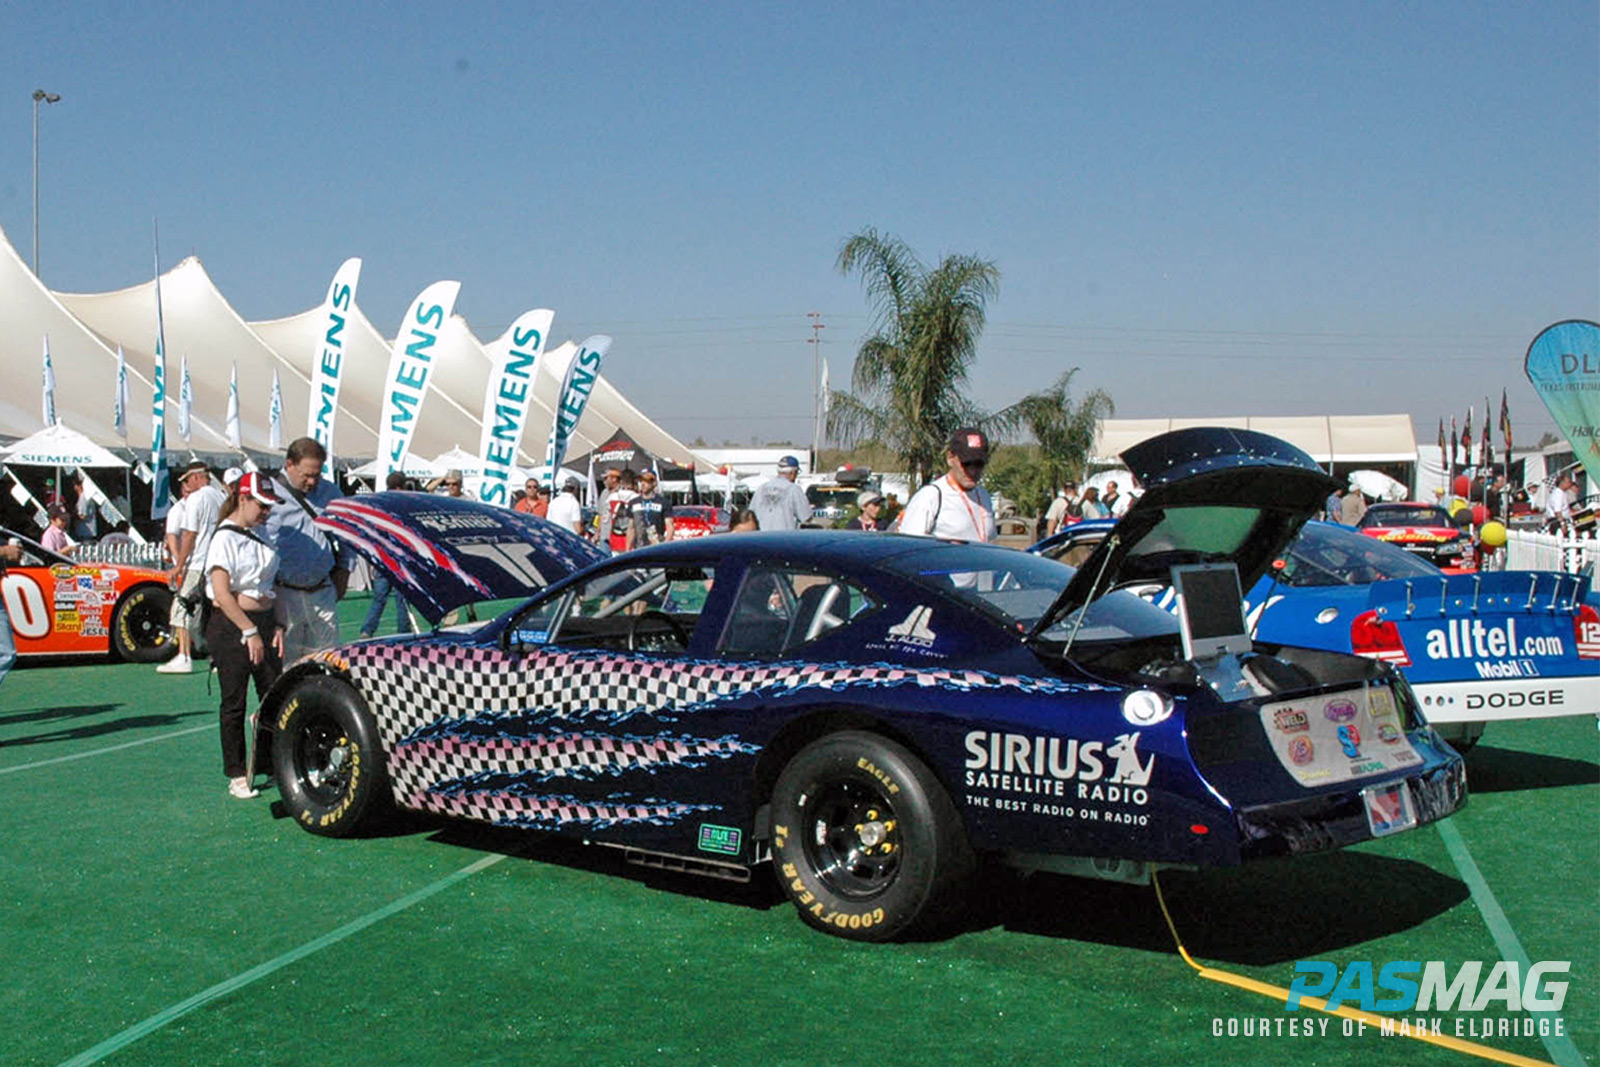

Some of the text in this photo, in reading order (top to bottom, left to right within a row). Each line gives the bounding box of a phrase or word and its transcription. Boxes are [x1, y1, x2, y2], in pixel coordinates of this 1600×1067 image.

[1562, 353, 1600, 374] DL
[480, 326, 541, 505] SIEMENS
[21, 454, 93, 464] SIEMENS
[101, 592, 117, 601] 3M
[1426, 618, 1564, 660] alltel.com
[1475, 659, 1519, 678] Mobil
[279, 699, 299, 730] EAGLE
[1466, 690, 1564, 710] DODGE
[964, 730, 1104, 782] SIRIUS
[320, 742, 360, 826] GOODYEAR
[857, 757, 900, 794] EAGLE
[965, 770, 1148, 806] SATELLITE RADIO
[966, 795, 989, 808] THE
[995, 798, 1027, 812] BEST
[1033, 803, 1074, 818] RADIO
[1080, 808, 1099, 820] ON
[782, 862, 886, 929] GOODYEAR
